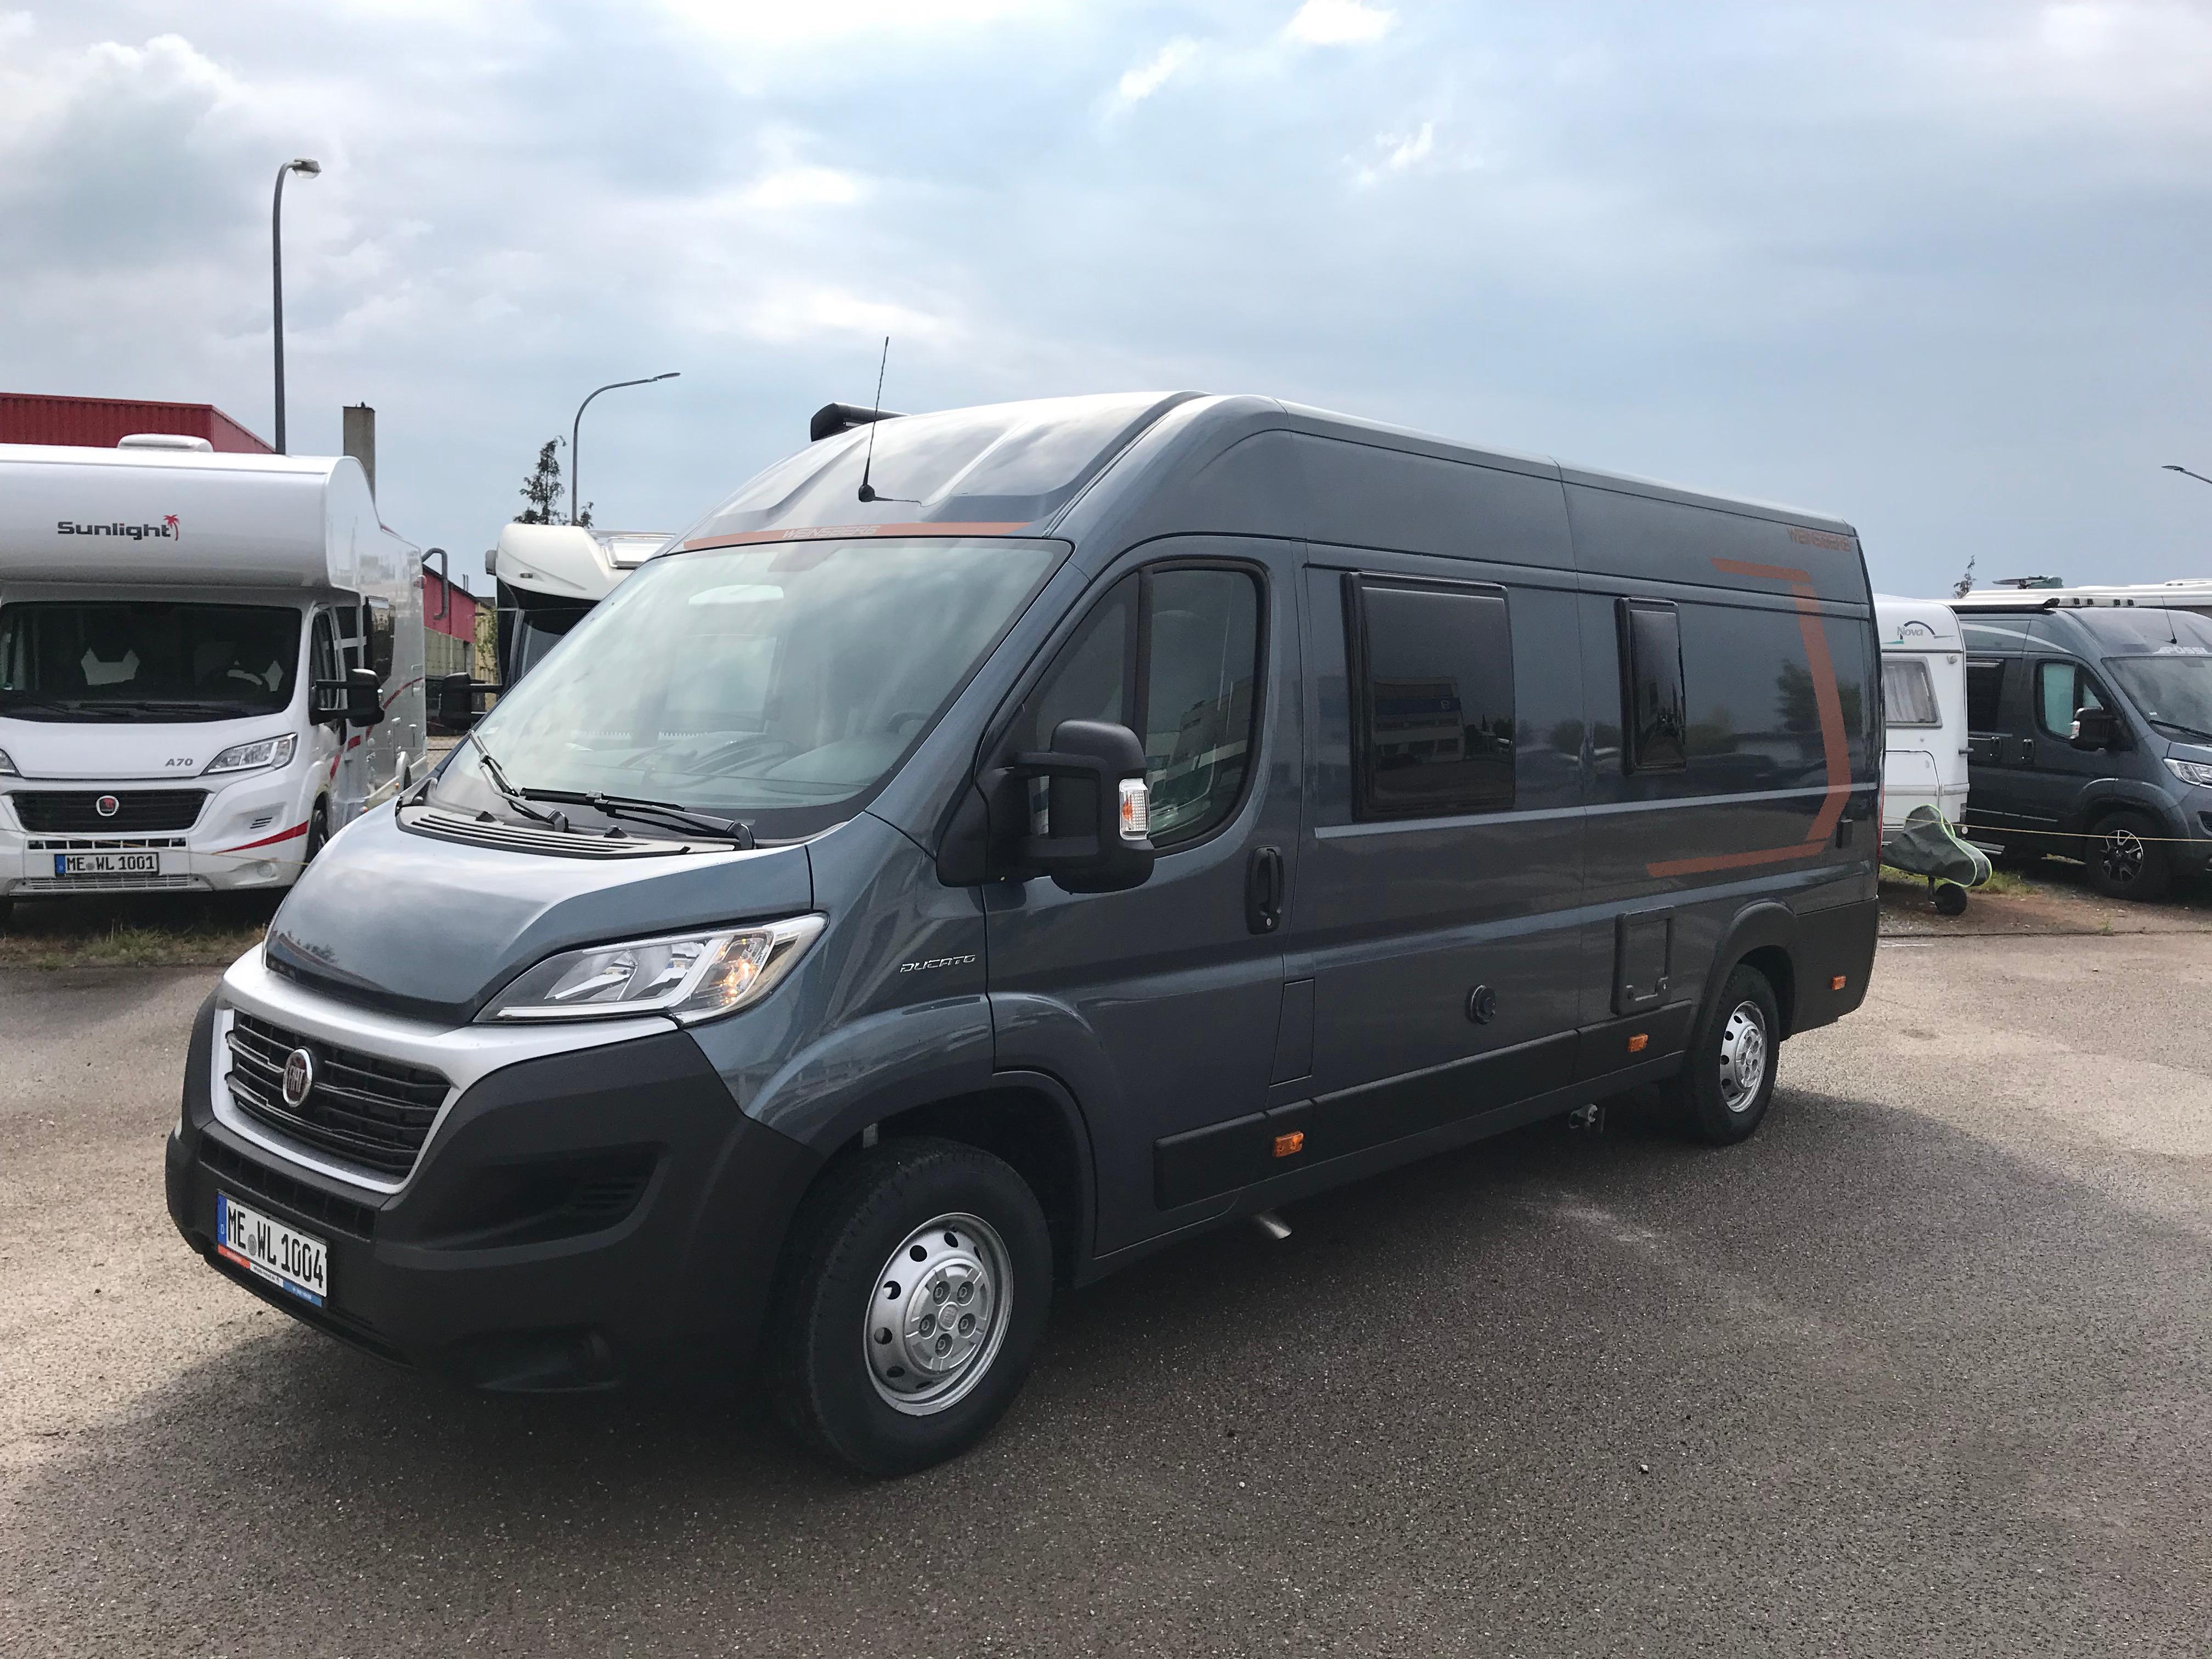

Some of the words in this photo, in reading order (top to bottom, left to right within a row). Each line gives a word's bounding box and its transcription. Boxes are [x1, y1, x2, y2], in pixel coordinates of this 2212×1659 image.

[58, 521, 171, 540] Sunlight
[782, 525, 882, 539] WEINSBERG
[1897, 626, 1923, 636] Nova
[165, 758, 193, 766] A70
[67, 857, 86, 871] ME
[96, 856, 115, 871] WL
[119, 856, 154, 870] 1001
[900, 955, 976, 973] DUCATO
[288, 1065, 306, 1093] FIAT
[228, 1205, 246, 1250] ME
[257, 1221, 277, 1266] WL
[281, 1234, 324, 1289] 1004
